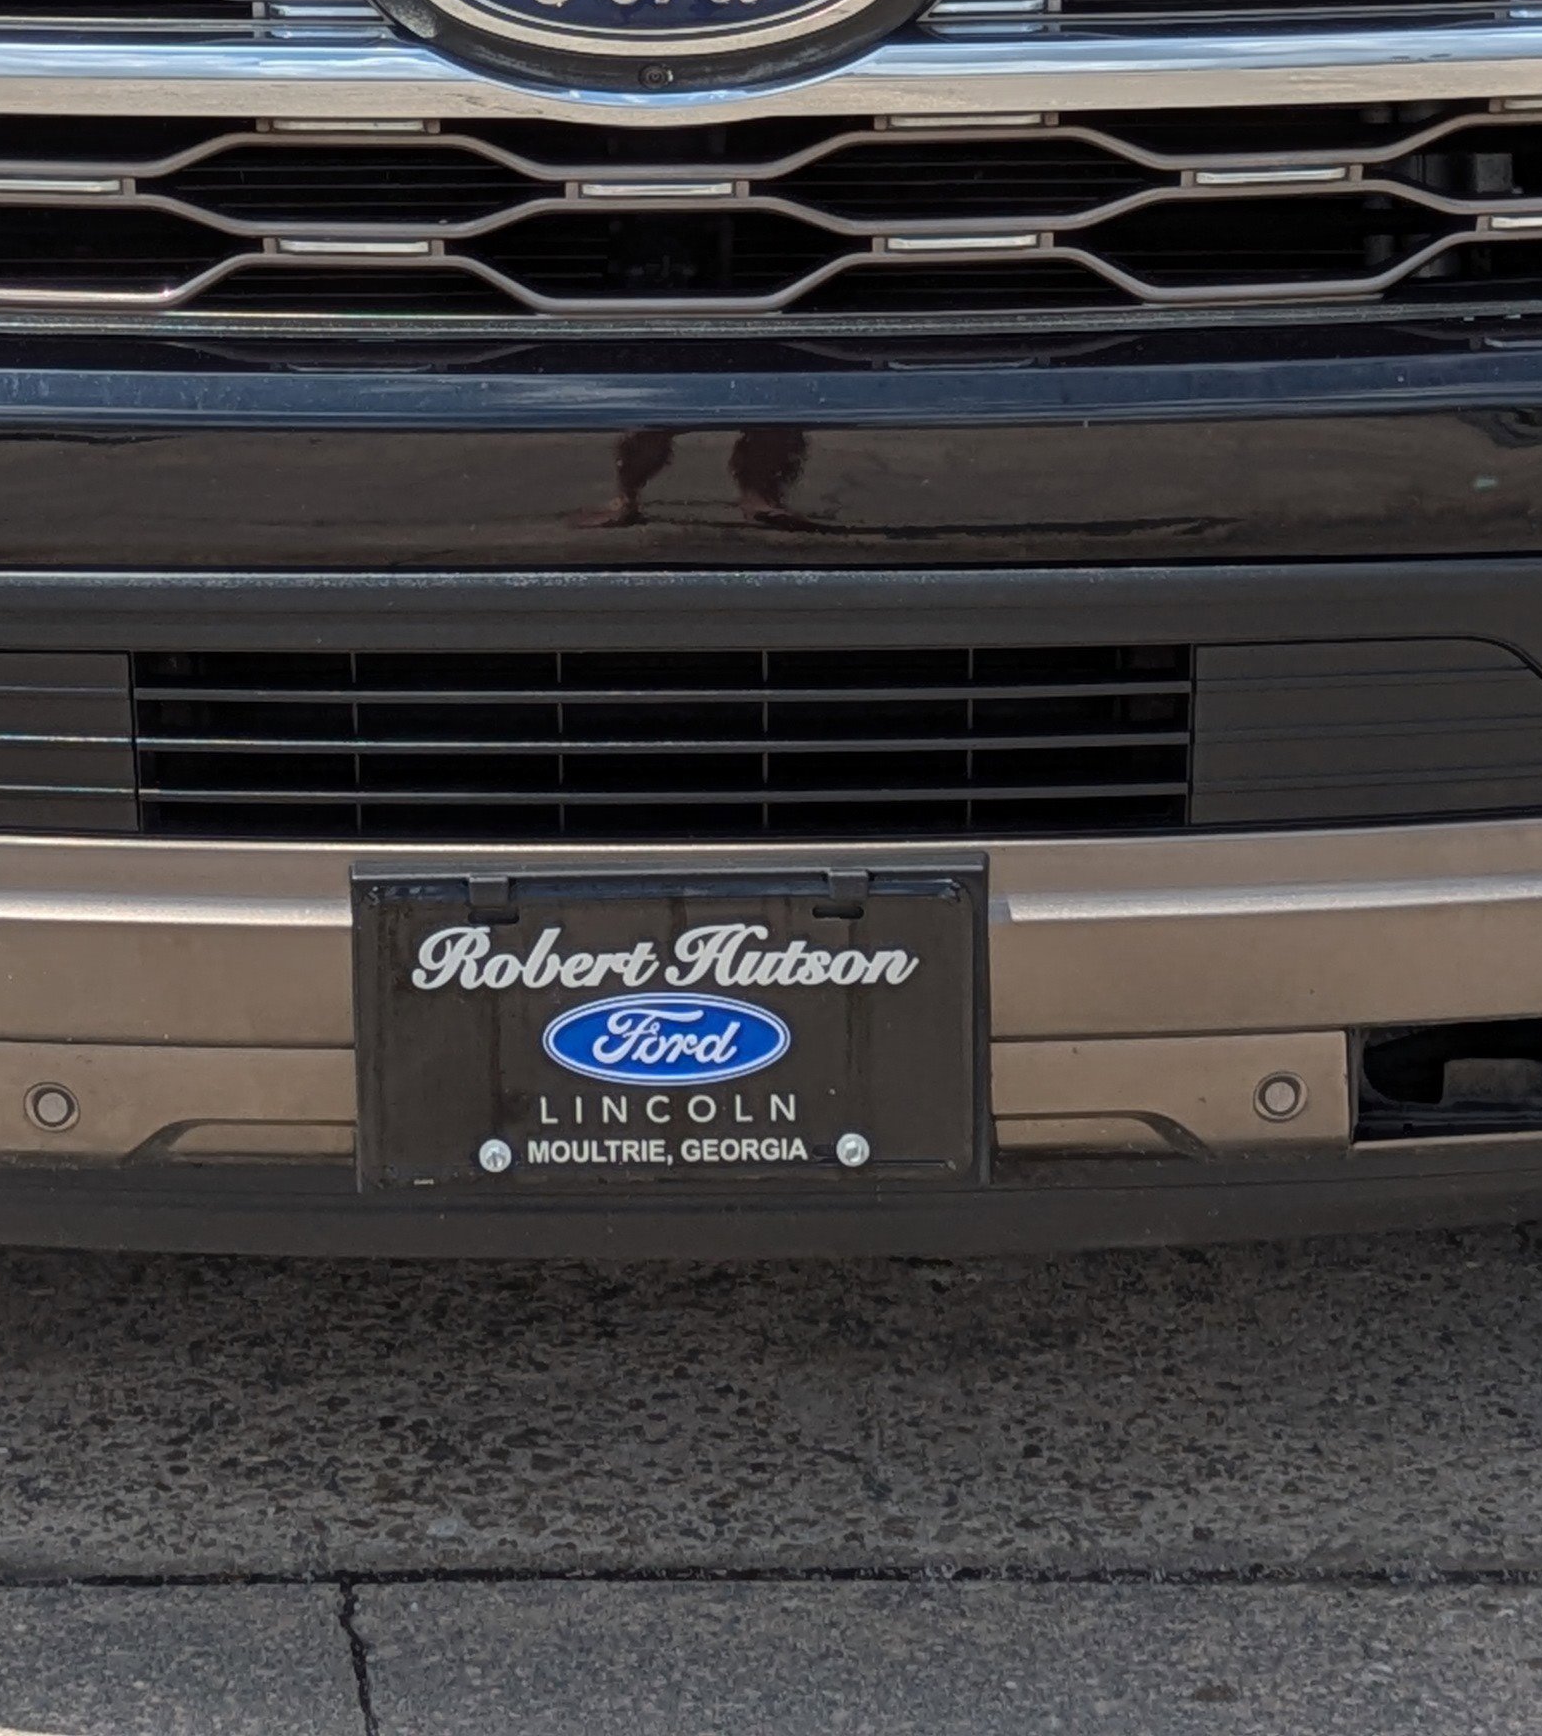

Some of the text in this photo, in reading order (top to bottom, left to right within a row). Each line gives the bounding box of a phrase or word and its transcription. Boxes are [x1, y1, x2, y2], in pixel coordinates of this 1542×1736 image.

[412, 923, 919, 990] Robert Hutson
[592, 1009, 740, 1064] Ford
[540, 1094, 795, 1124] LINCOLN
[528, 1137, 808, 1165] MOULTRIE, GEORGIA
